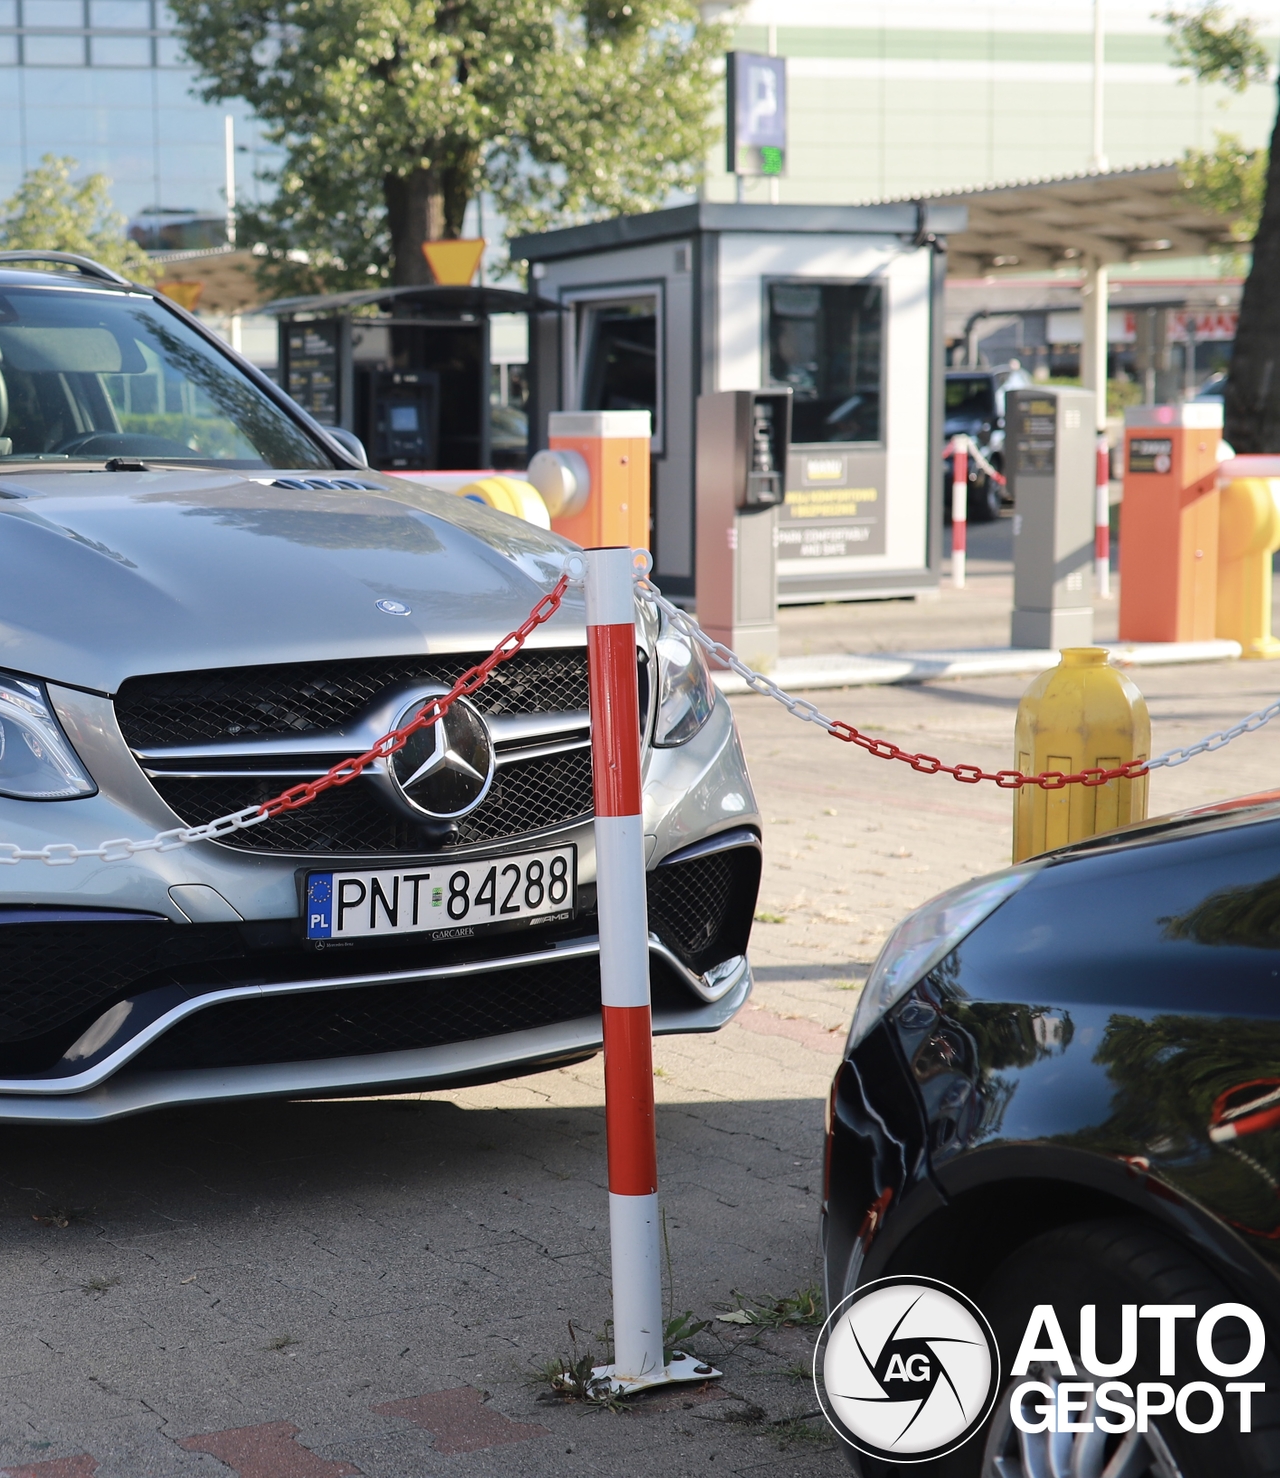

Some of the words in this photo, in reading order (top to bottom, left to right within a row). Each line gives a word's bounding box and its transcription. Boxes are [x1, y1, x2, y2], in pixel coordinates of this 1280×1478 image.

[337, 873, 430, 931] PNT
[447, 856, 568, 921] 84288
[311, 914, 328, 928] PL
[541, 912, 569, 923] AMG
[432, 927, 474, 939] GARCAREK
